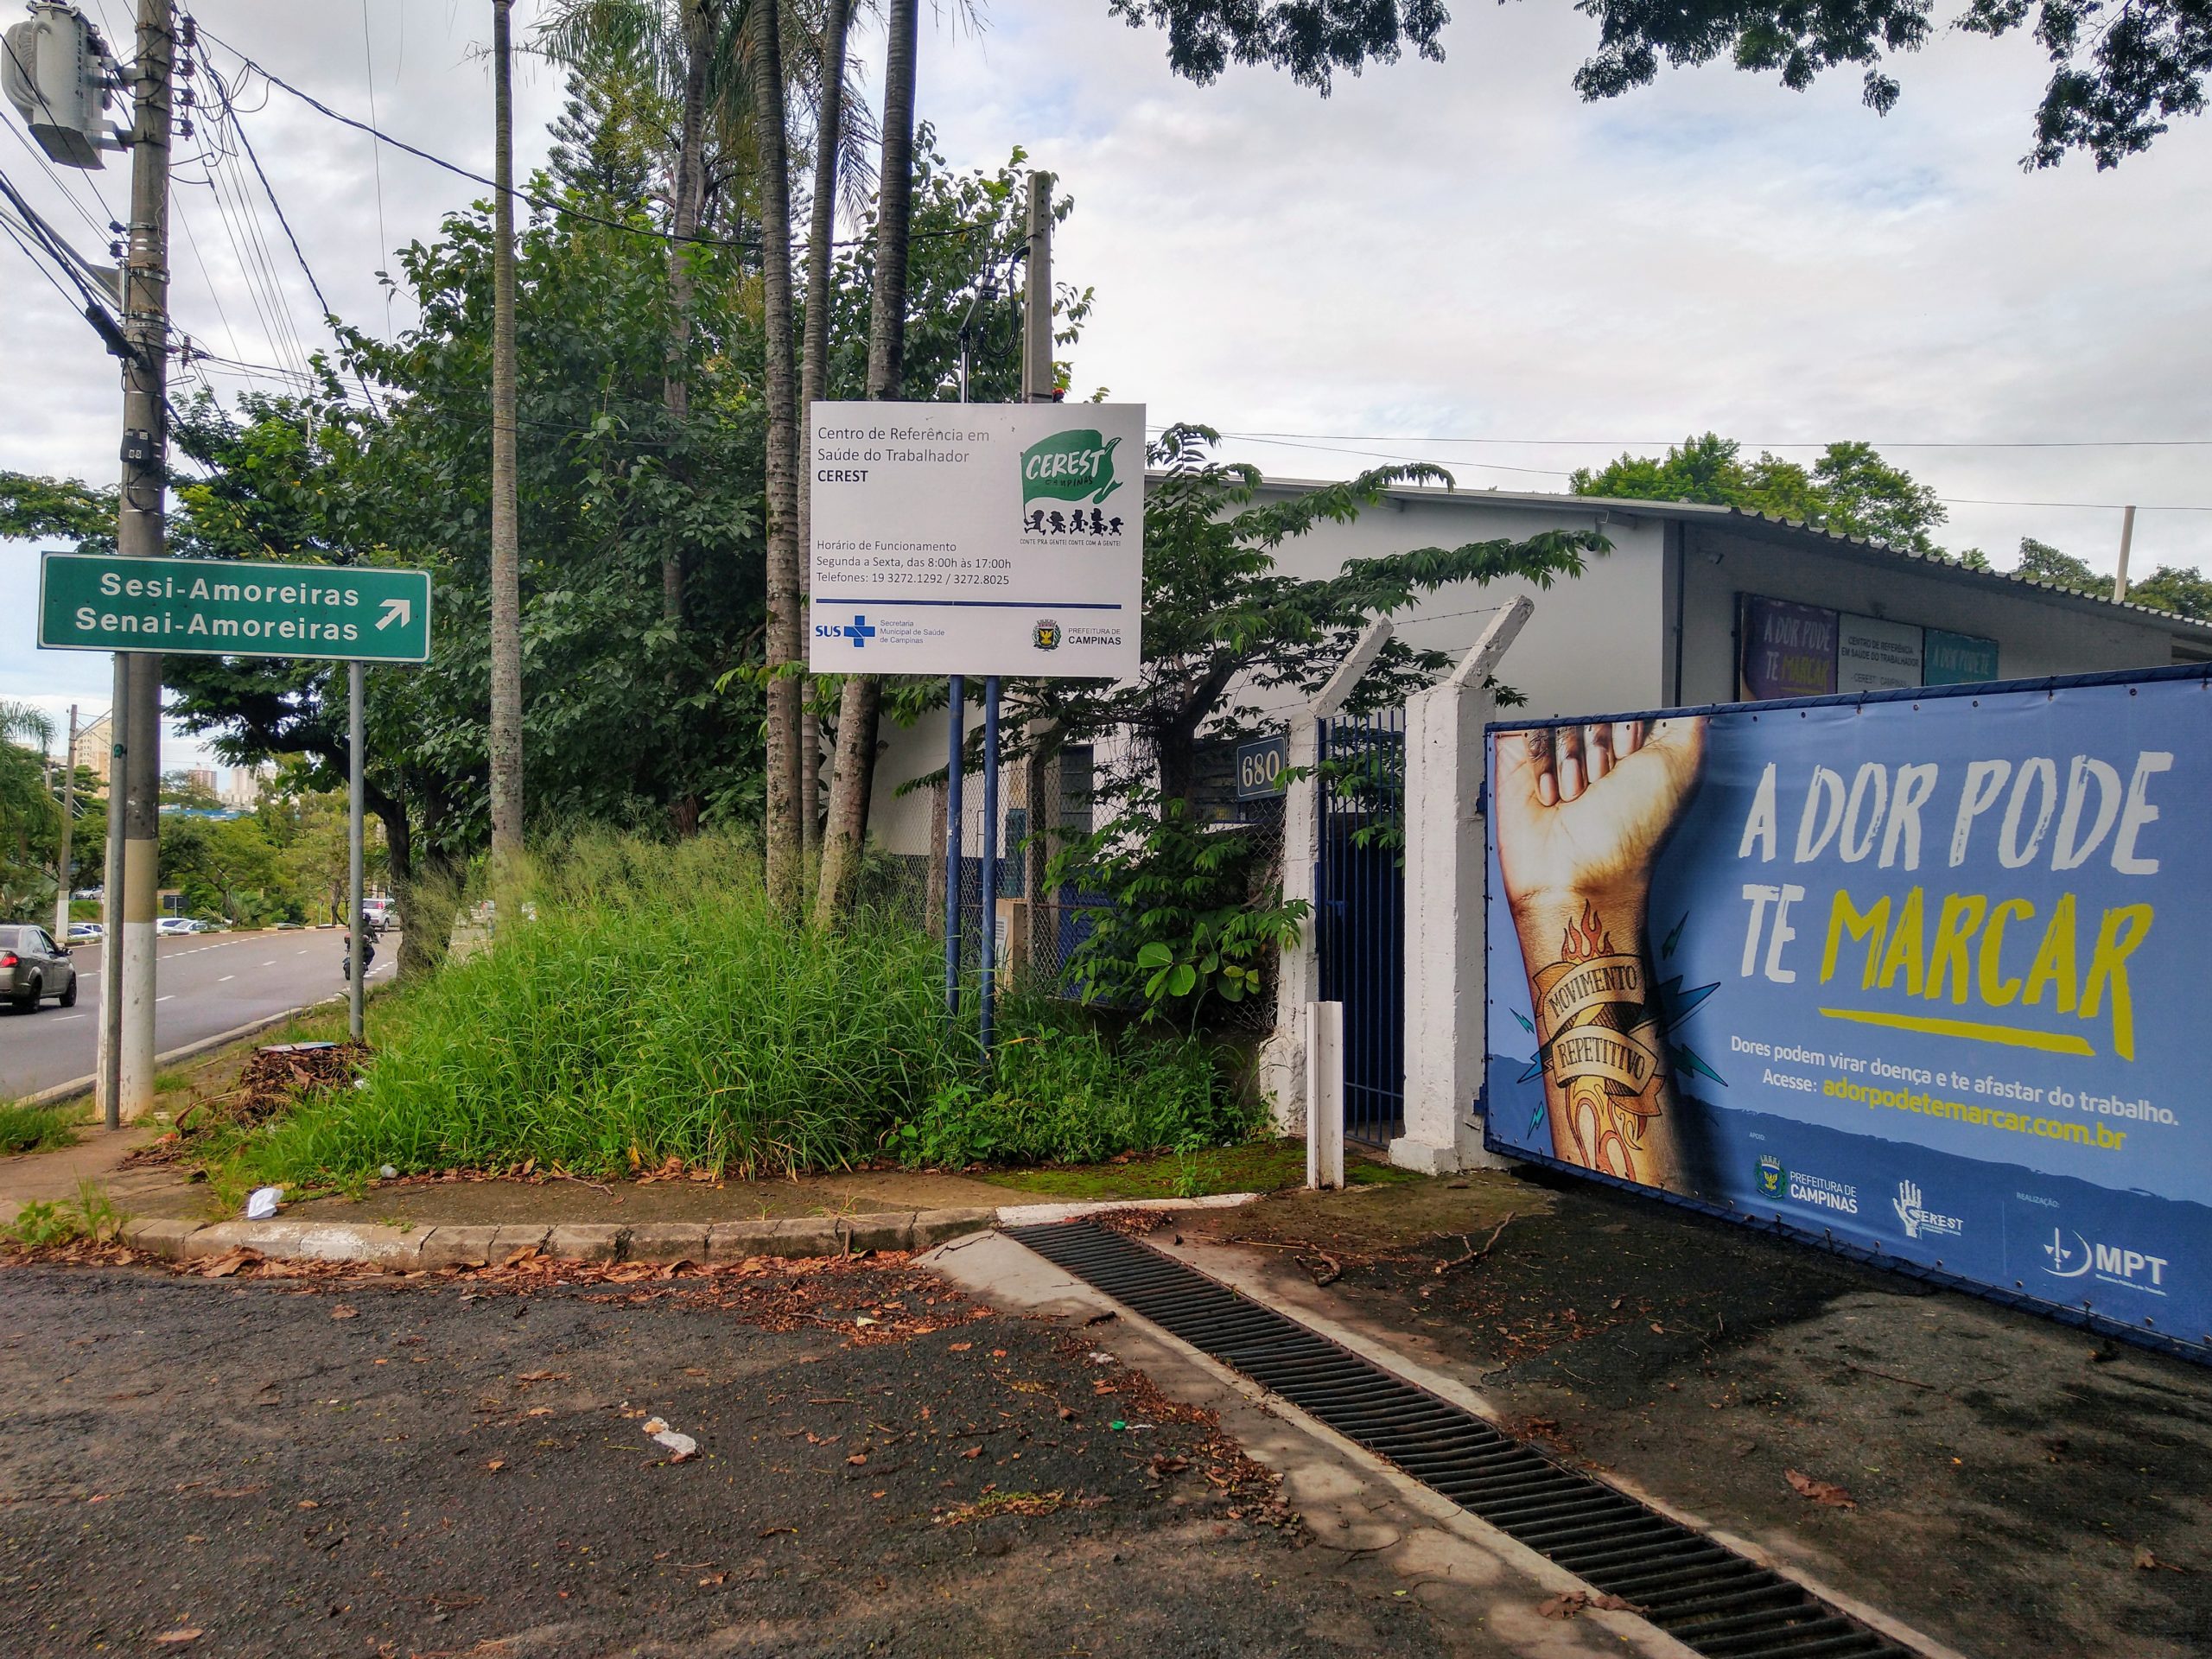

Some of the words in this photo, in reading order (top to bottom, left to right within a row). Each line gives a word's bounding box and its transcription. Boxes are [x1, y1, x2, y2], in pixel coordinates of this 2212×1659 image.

[817, 427, 864, 440] Centro
[868, 427, 886, 440] de
[890, 428, 963, 442] Referência
[968, 431, 989, 442] em
[817, 448, 860, 461] Saúde
[864, 448, 881, 461] do
[886, 449, 969, 462] Trabalhador
[1026, 448, 1105, 480] CEREST
[817, 470, 868, 482] CEREST
[1045, 476, 1093, 487] CAMPINAS
[817, 540, 856, 550] Horário
[859, 541, 872, 550] de
[874, 541, 957, 551] Funcionamento
[817, 556, 861, 568] Segunda
[873, 556, 904, 569] Sexta,
[906, 557, 925, 568] das
[928, 557, 957, 569] 8:00h
[961, 557, 972, 569] às
[976, 558, 1011, 569] 17:00h
[99, 572, 359, 607] Sesi-Amoreiras
[817, 572, 868, 583] Telefones:
[872, 573, 885, 582] 19
[888, 573, 943, 584] 3272.1292
[945, 573, 951, 585] /
[954, 575, 1009, 585] 3272.8025
[75, 607, 359, 641] Senai-Amoreiras
[815, 625, 841, 637] SUS
[880, 628, 912, 637] Municipal
[1764, 613, 1772, 642] A
[1775, 617, 1800, 647] DOR
[1802, 620, 1832, 652] PODE
[890, 636, 924, 645] Campinas
[1068, 636, 1122, 645] CAMPINAS
[1841, 646, 1850, 656] EM
[1766, 651, 1780, 681] TE
[1243, 750, 1280, 787] 680
[1738, 761, 1777, 863] A
[1795, 762, 1939, 871] DOR
[1949, 751, 2174, 875] PODE
[1741, 884, 1805, 983] TE
[1819, 885, 2154, 1062] MARCAR
[1548, 965, 1637, 1019] MOVIMENTO
[1557, 1036, 1645, 1080] REPETITIVO
[1731, 1035, 1770, 1058] Dores
[1774, 1045, 1825, 1066] podem
[1829, 1052, 1866, 1073] virar
[1871, 1058, 1931, 1085] doença
[1936, 1072, 1947, 1086] e
[1950, 1071, 1969, 1091] te
[1974, 1075, 2044, 1103] afastar
[2048, 1086, 2075, 1108] do
[2079, 1091, 2178, 1126] trabalho.
[1763, 1068, 1817, 1093] Acesse:
[1822, 1076, 2126, 1151] adorpodetemarcar.com.br
[1789, 1171, 1842, 1195] PREFEITURA
[1844, 1185, 1857, 1197] DE
[1790, 1183, 1858, 1214] CAMPINAS
[2016, 1192, 2060, 1209] REALIZAÇÃO:
[2096, 1243, 2168, 1285] MPT
